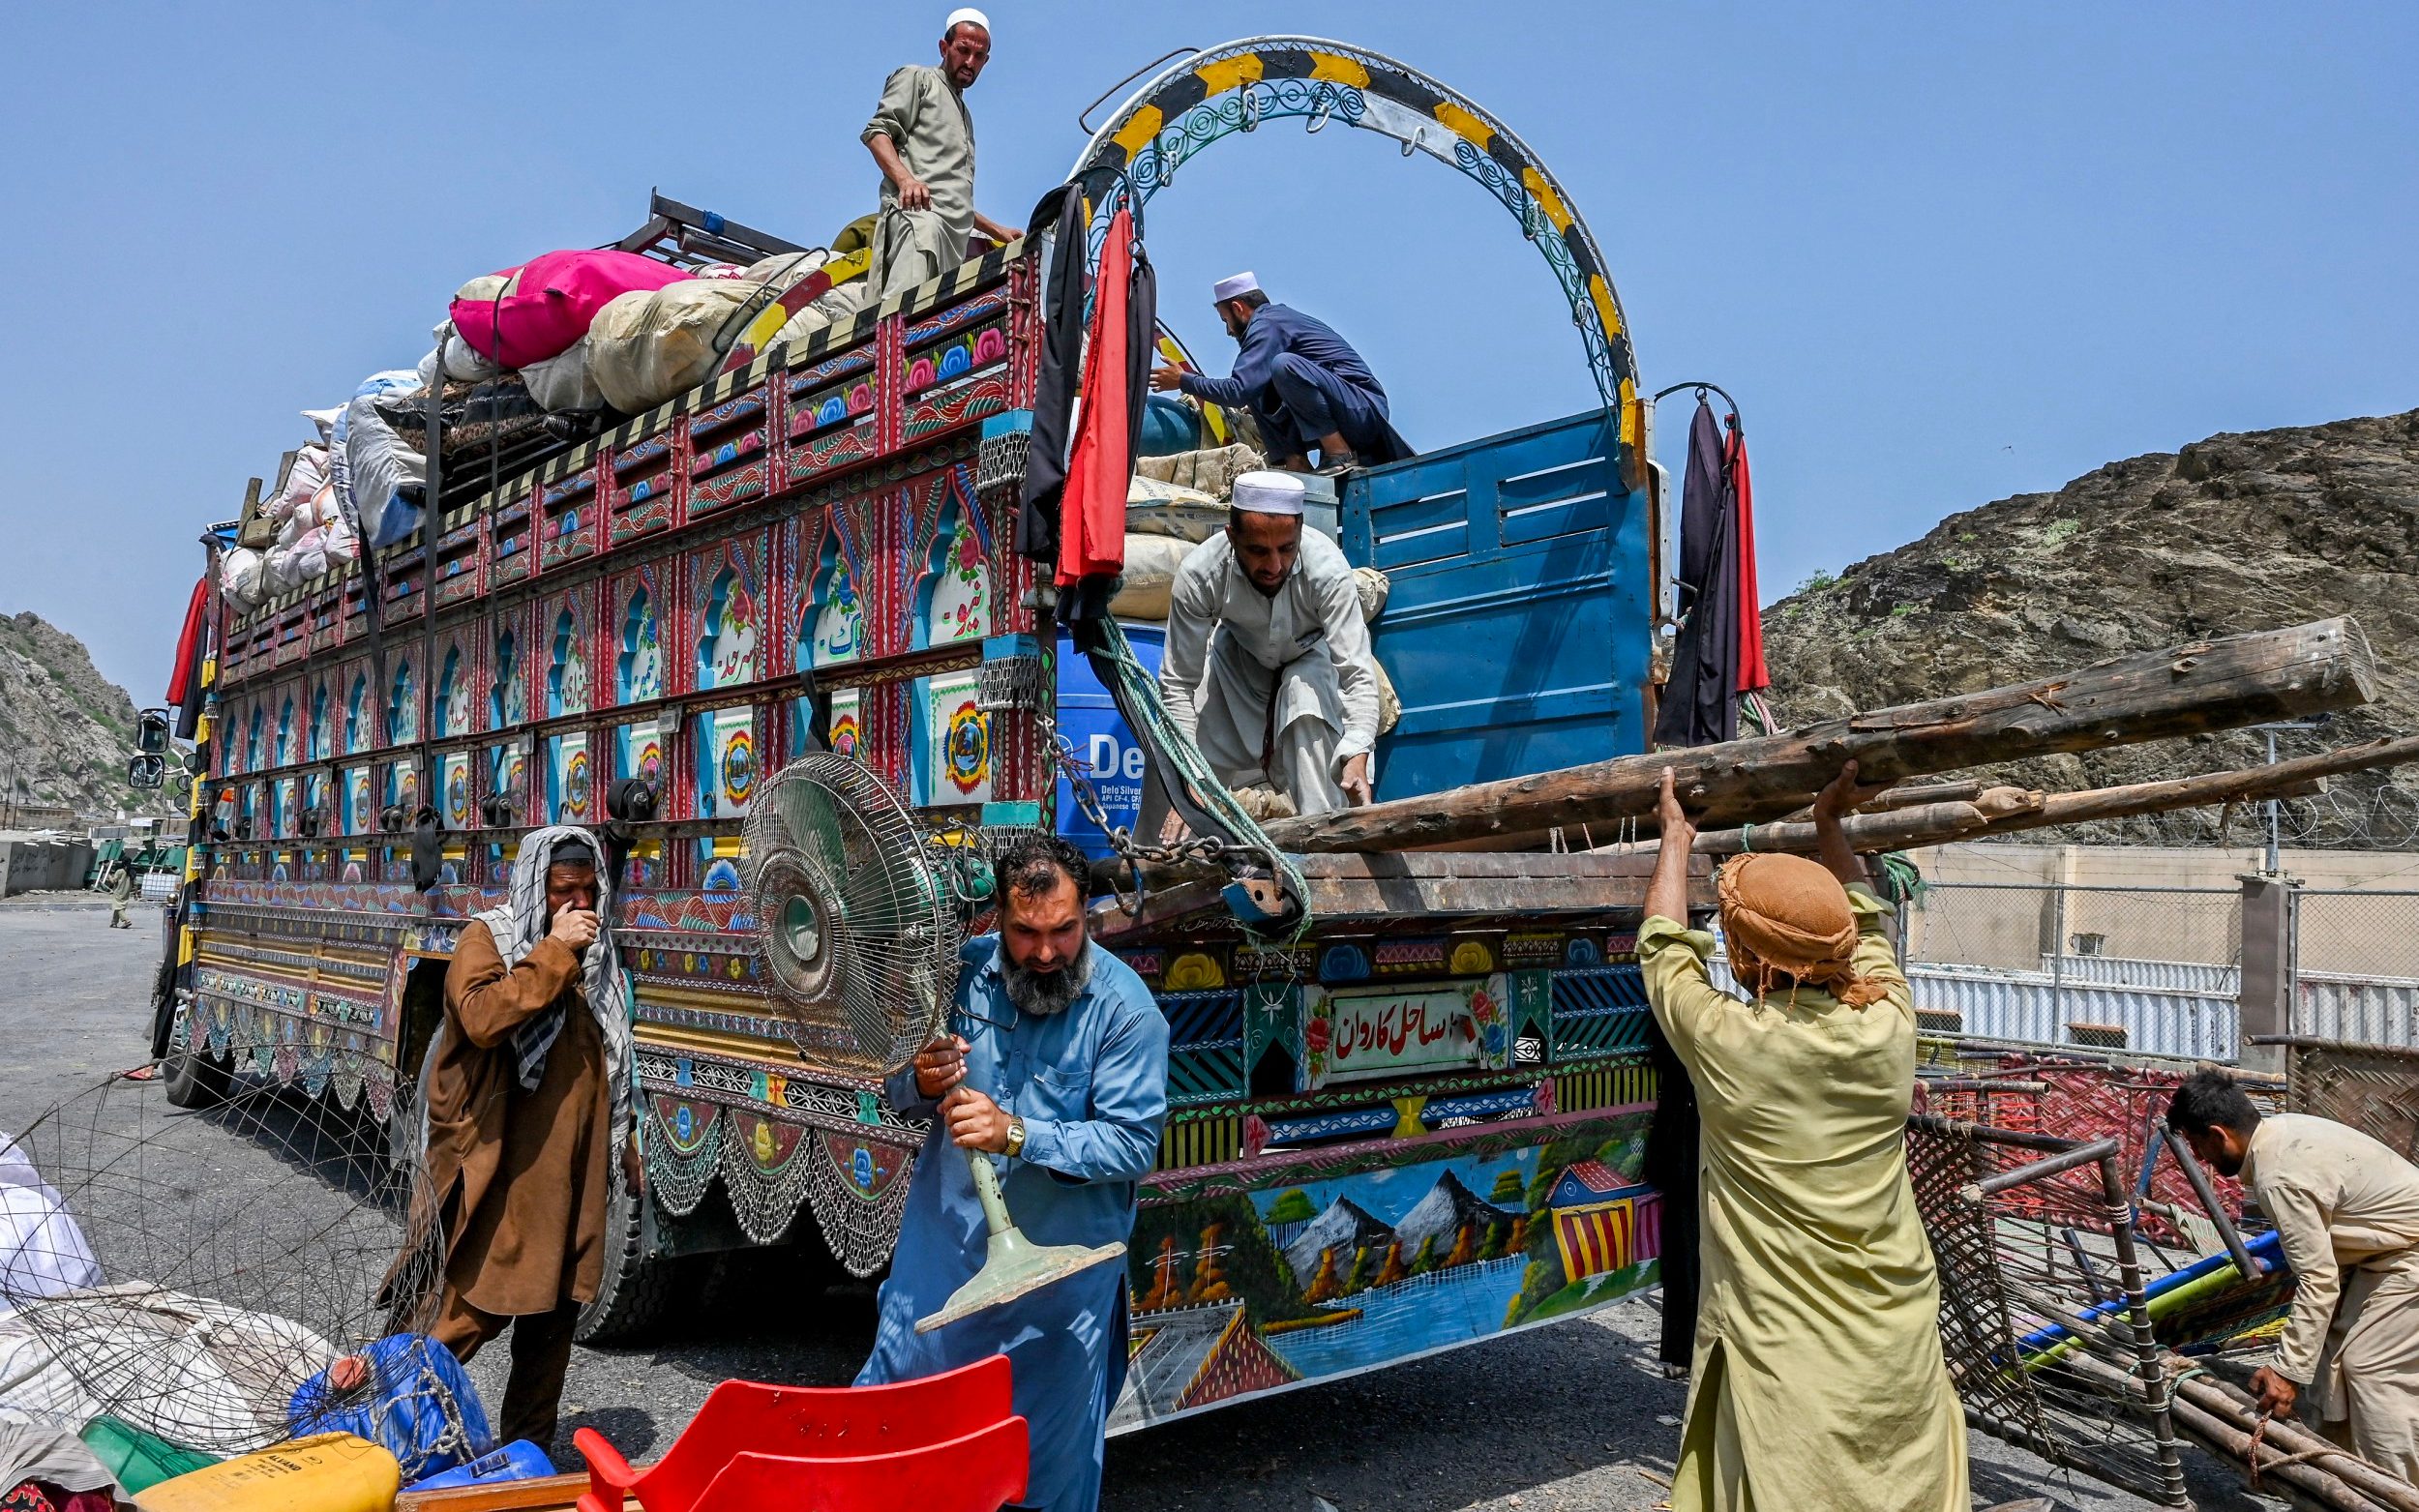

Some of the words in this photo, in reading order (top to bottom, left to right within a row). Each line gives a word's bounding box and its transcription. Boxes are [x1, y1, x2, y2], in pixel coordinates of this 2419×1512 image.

[1090, 733, 1146, 779] De
[1101, 785, 1120, 795] Delo
[1120, 785, 1142, 795] Silver
[1335, 1004, 1397, 1060] کاروان
[266, 1454, 303, 1471] ALVAND
